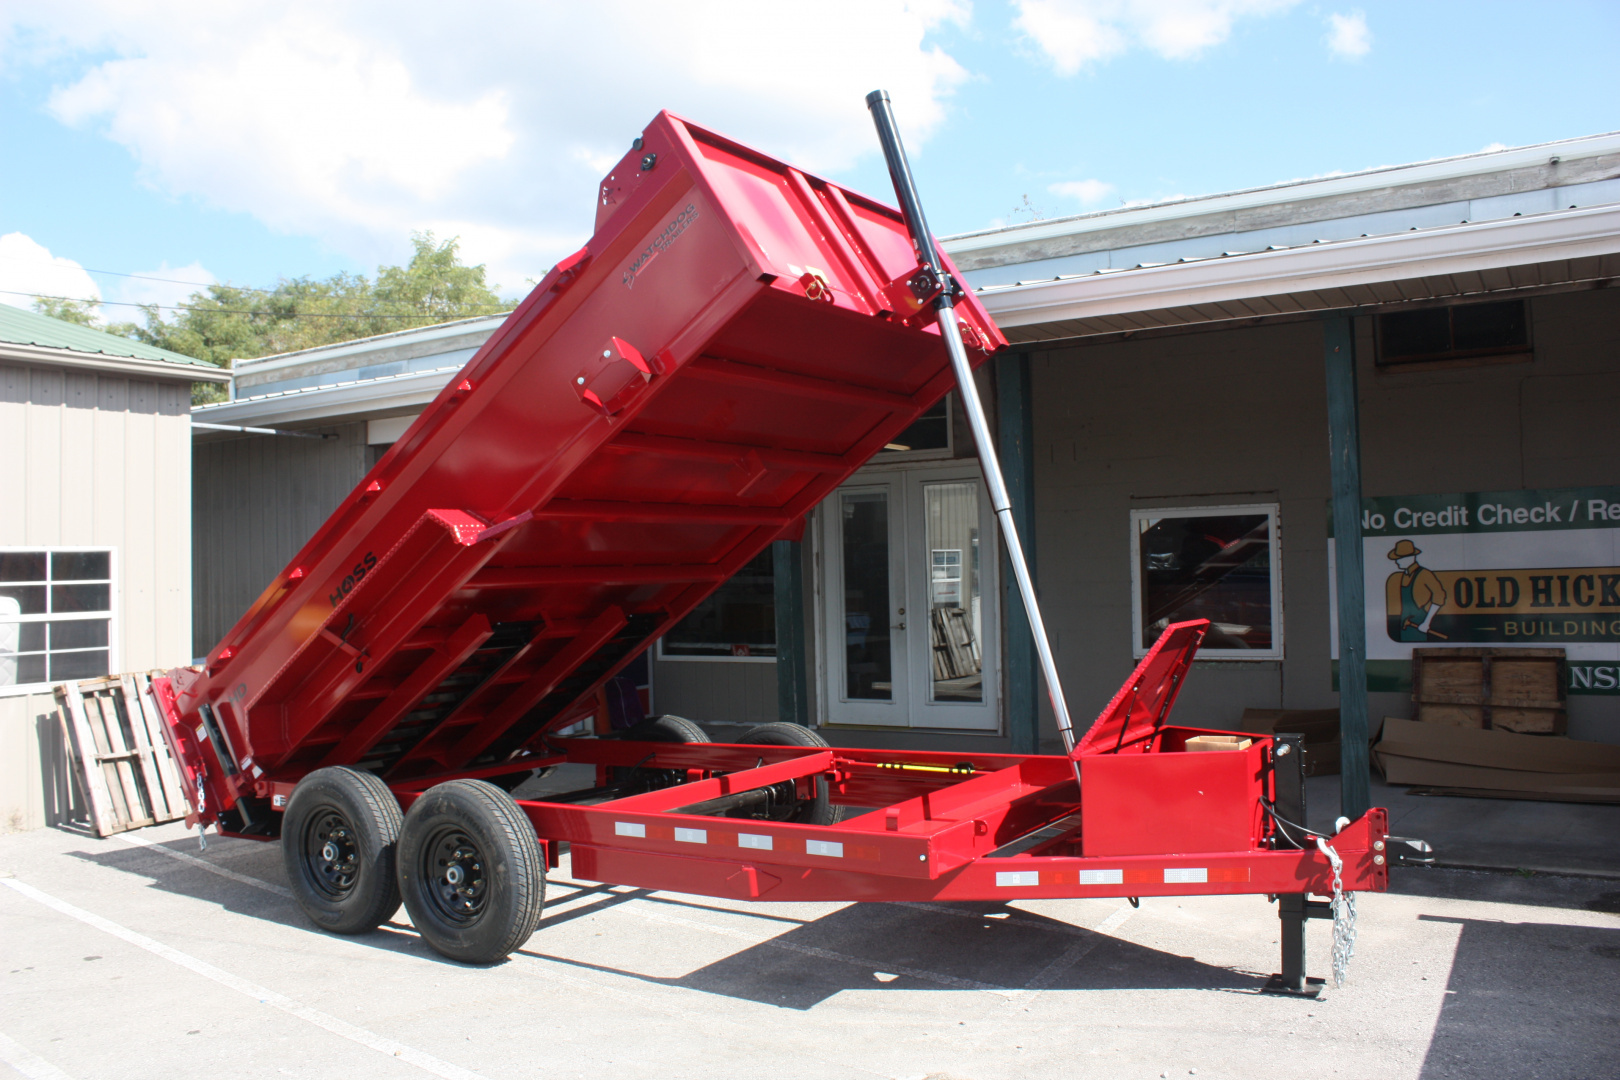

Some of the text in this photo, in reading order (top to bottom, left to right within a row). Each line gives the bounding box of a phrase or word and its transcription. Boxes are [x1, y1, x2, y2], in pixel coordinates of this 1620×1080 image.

[629, 203, 696, 272] WATCHDOG
[660, 211, 699, 252] TRAILERS
[1393, 505, 1469, 528] Credit
[1477, 501, 1561, 525] Check
[1568, 500, 1579, 521] /
[329, 551, 377, 608] HOSS
[1454, 574, 1620, 608] OLD HICK
[228, 683, 248, 707] HD
